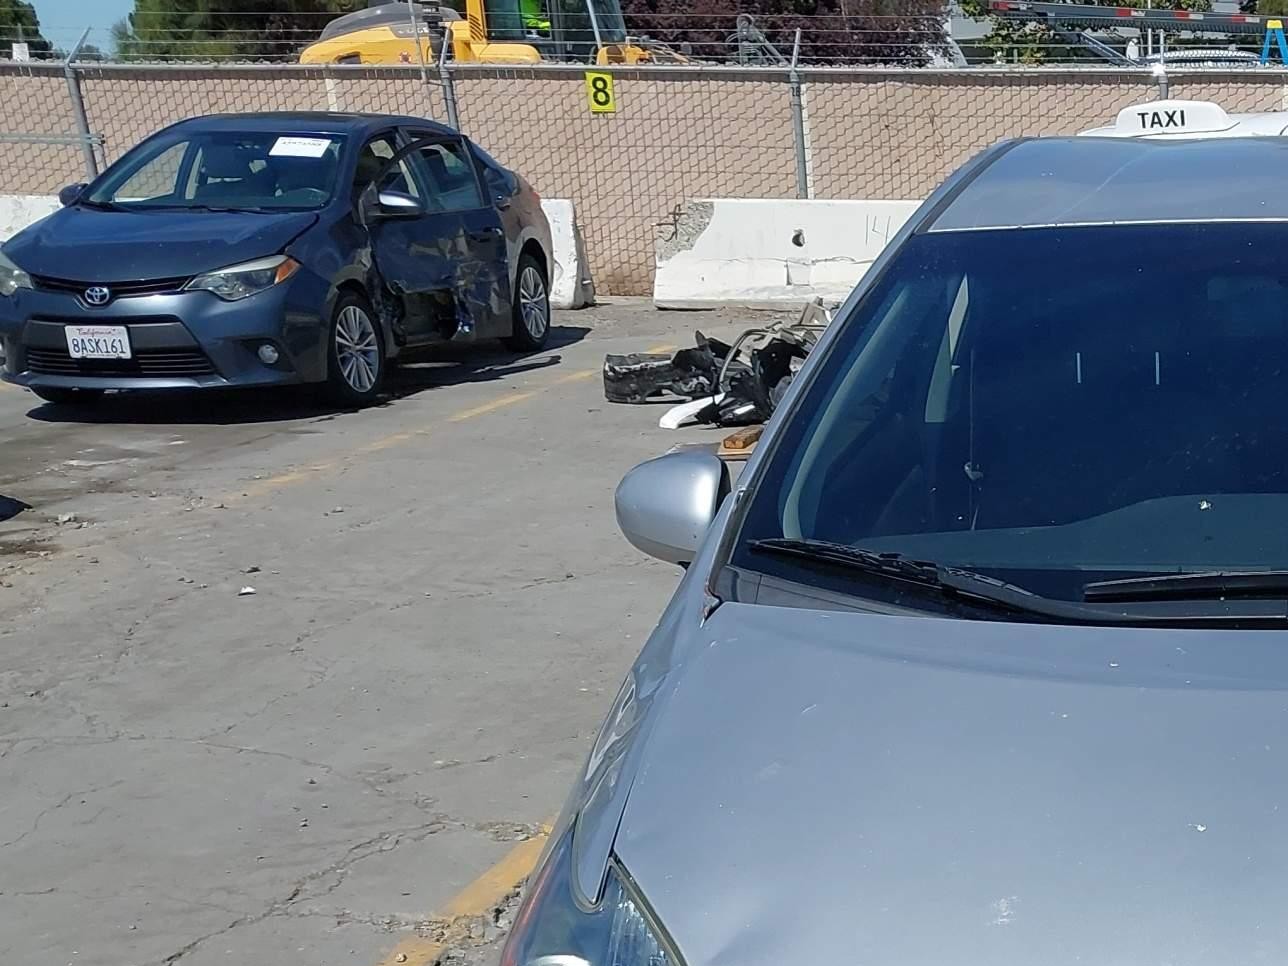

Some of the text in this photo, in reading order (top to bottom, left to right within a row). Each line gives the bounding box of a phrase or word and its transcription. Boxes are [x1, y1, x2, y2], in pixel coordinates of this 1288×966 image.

[592, 77, 610, 106] 8
[1137, 109, 1186, 129] TAXI
[77, 327, 115, 337] California
[71, 338, 127, 354] 8ASK161
